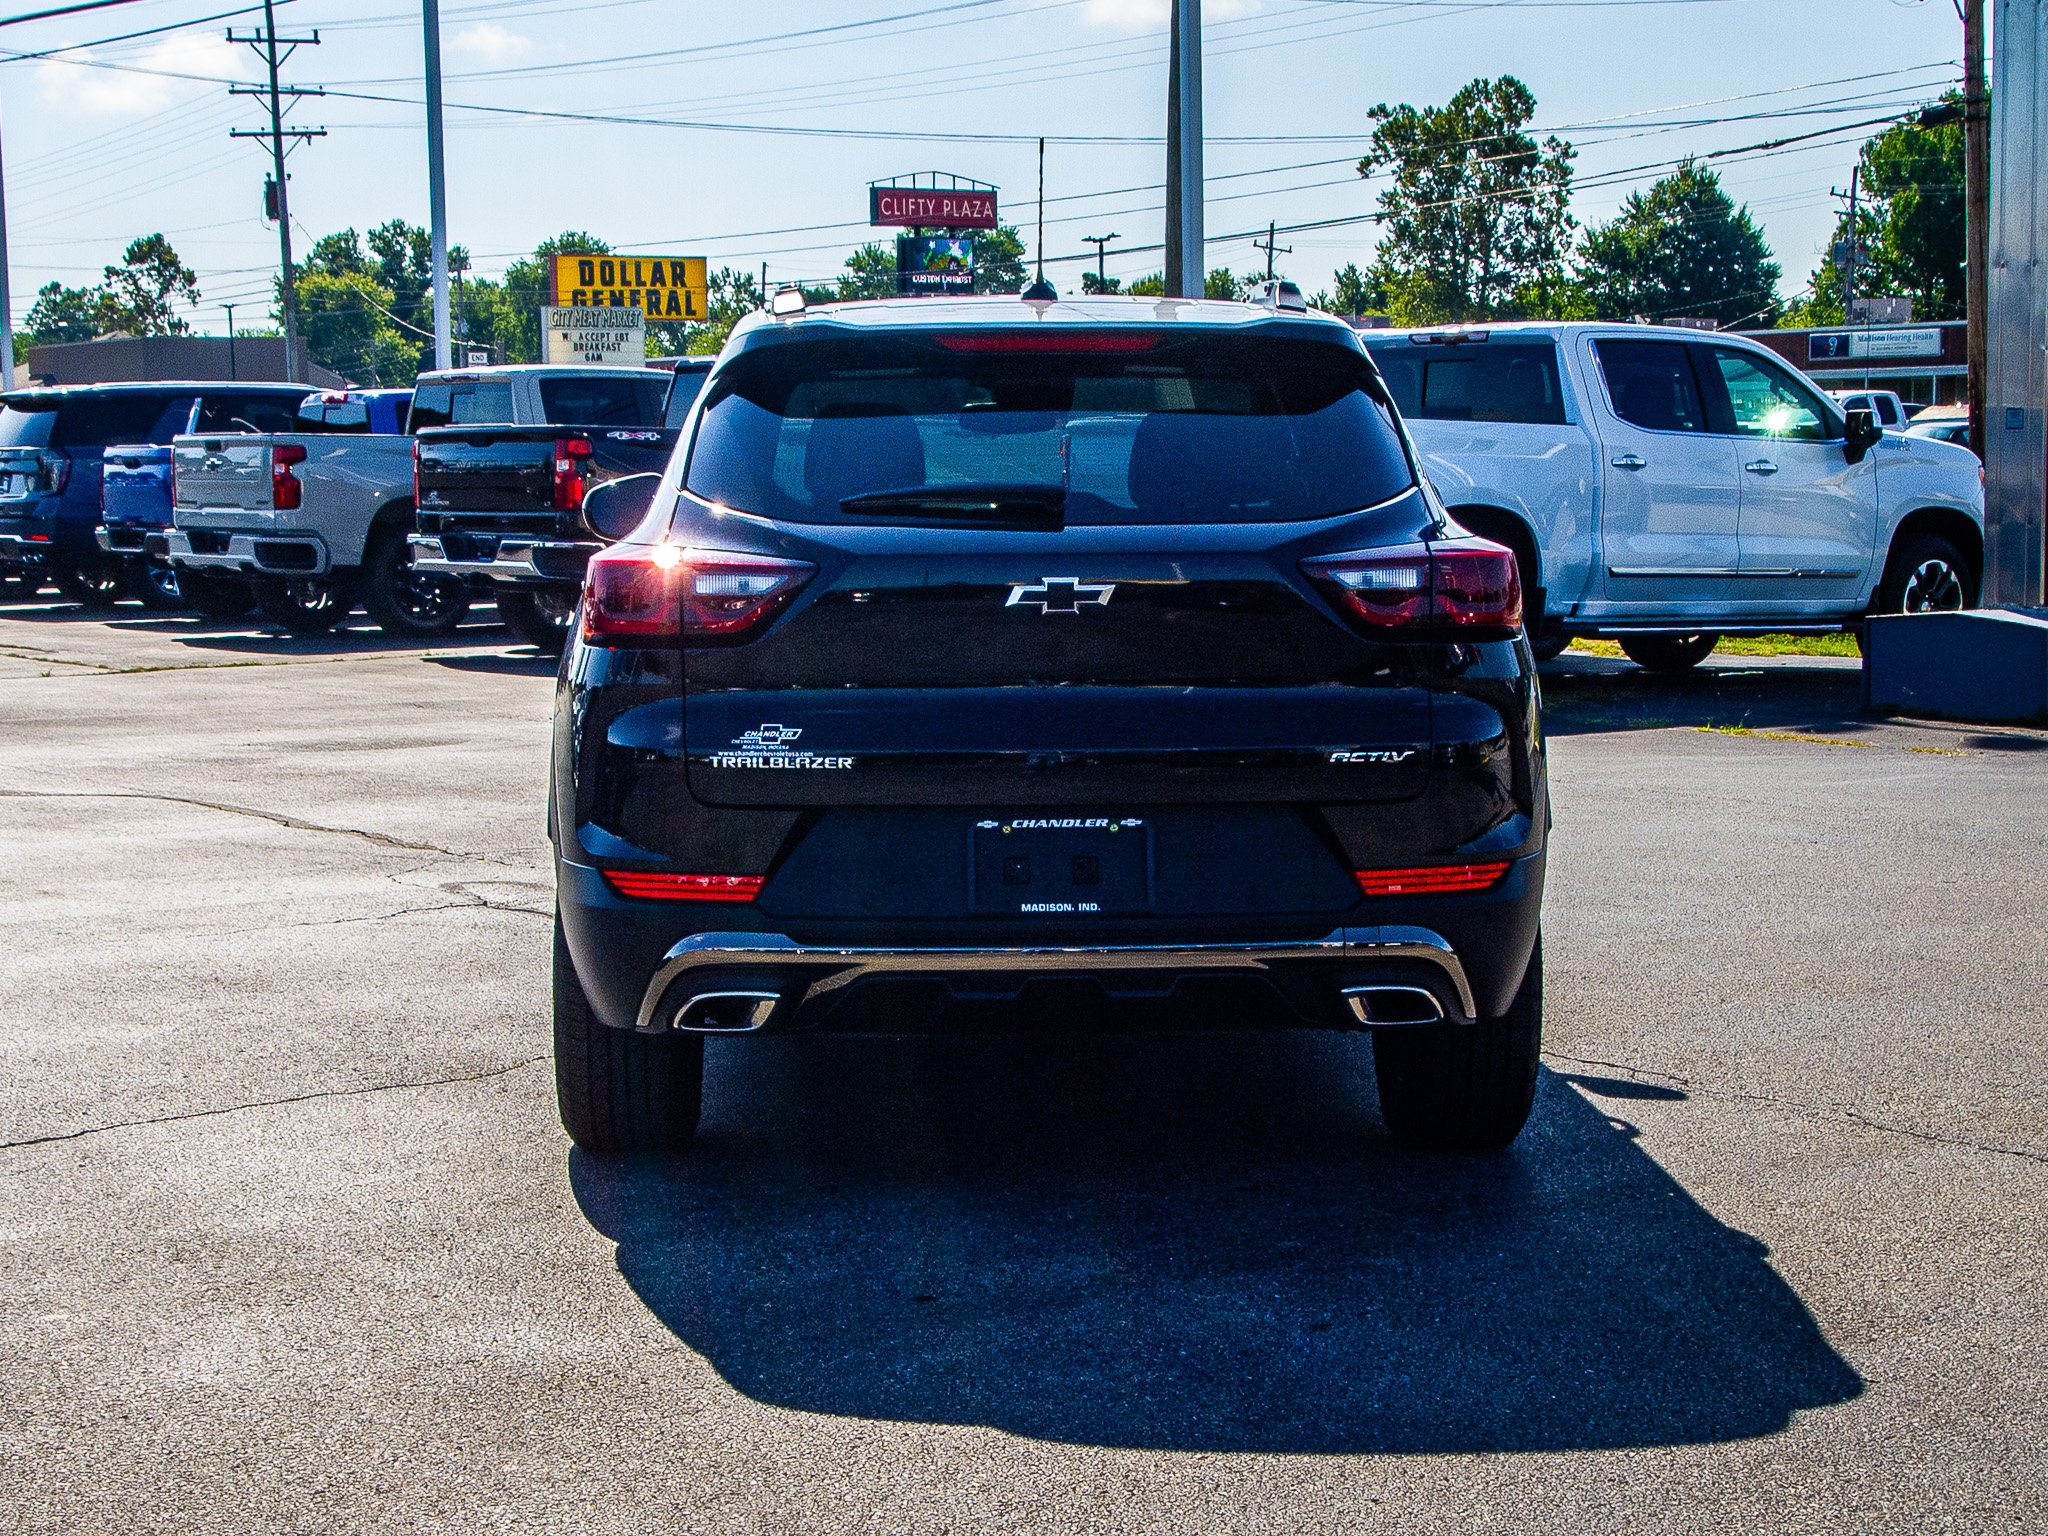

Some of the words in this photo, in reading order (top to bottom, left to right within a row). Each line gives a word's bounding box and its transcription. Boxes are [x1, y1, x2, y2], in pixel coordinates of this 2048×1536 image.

[881, 197, 935, 216] CLIFTY
[943, 200, 993, 218] PLAZA
[578, 260, 687, 288] DOLLAR
[571, 288, 697, 316] GENERAL
[551, 309, 575, 327] CITY
[573, 309, 602, 328] MEAT
[601, 309, 641, 328] MARKET
[578, 332, 611, 342] ACCEPT
[614, 332, 630, 342] EBT
[573, 342, 622, 352] BREAKFAST
[585, 353, 604, 362] 6AM
[1329, 750, 1415, 762] ACTIV
[710, 757, 853, 769] TRAILBLAZER
[1012, 819, 1109, 828] CHANDLER
[1078, 903, 1101, 911] IND.
